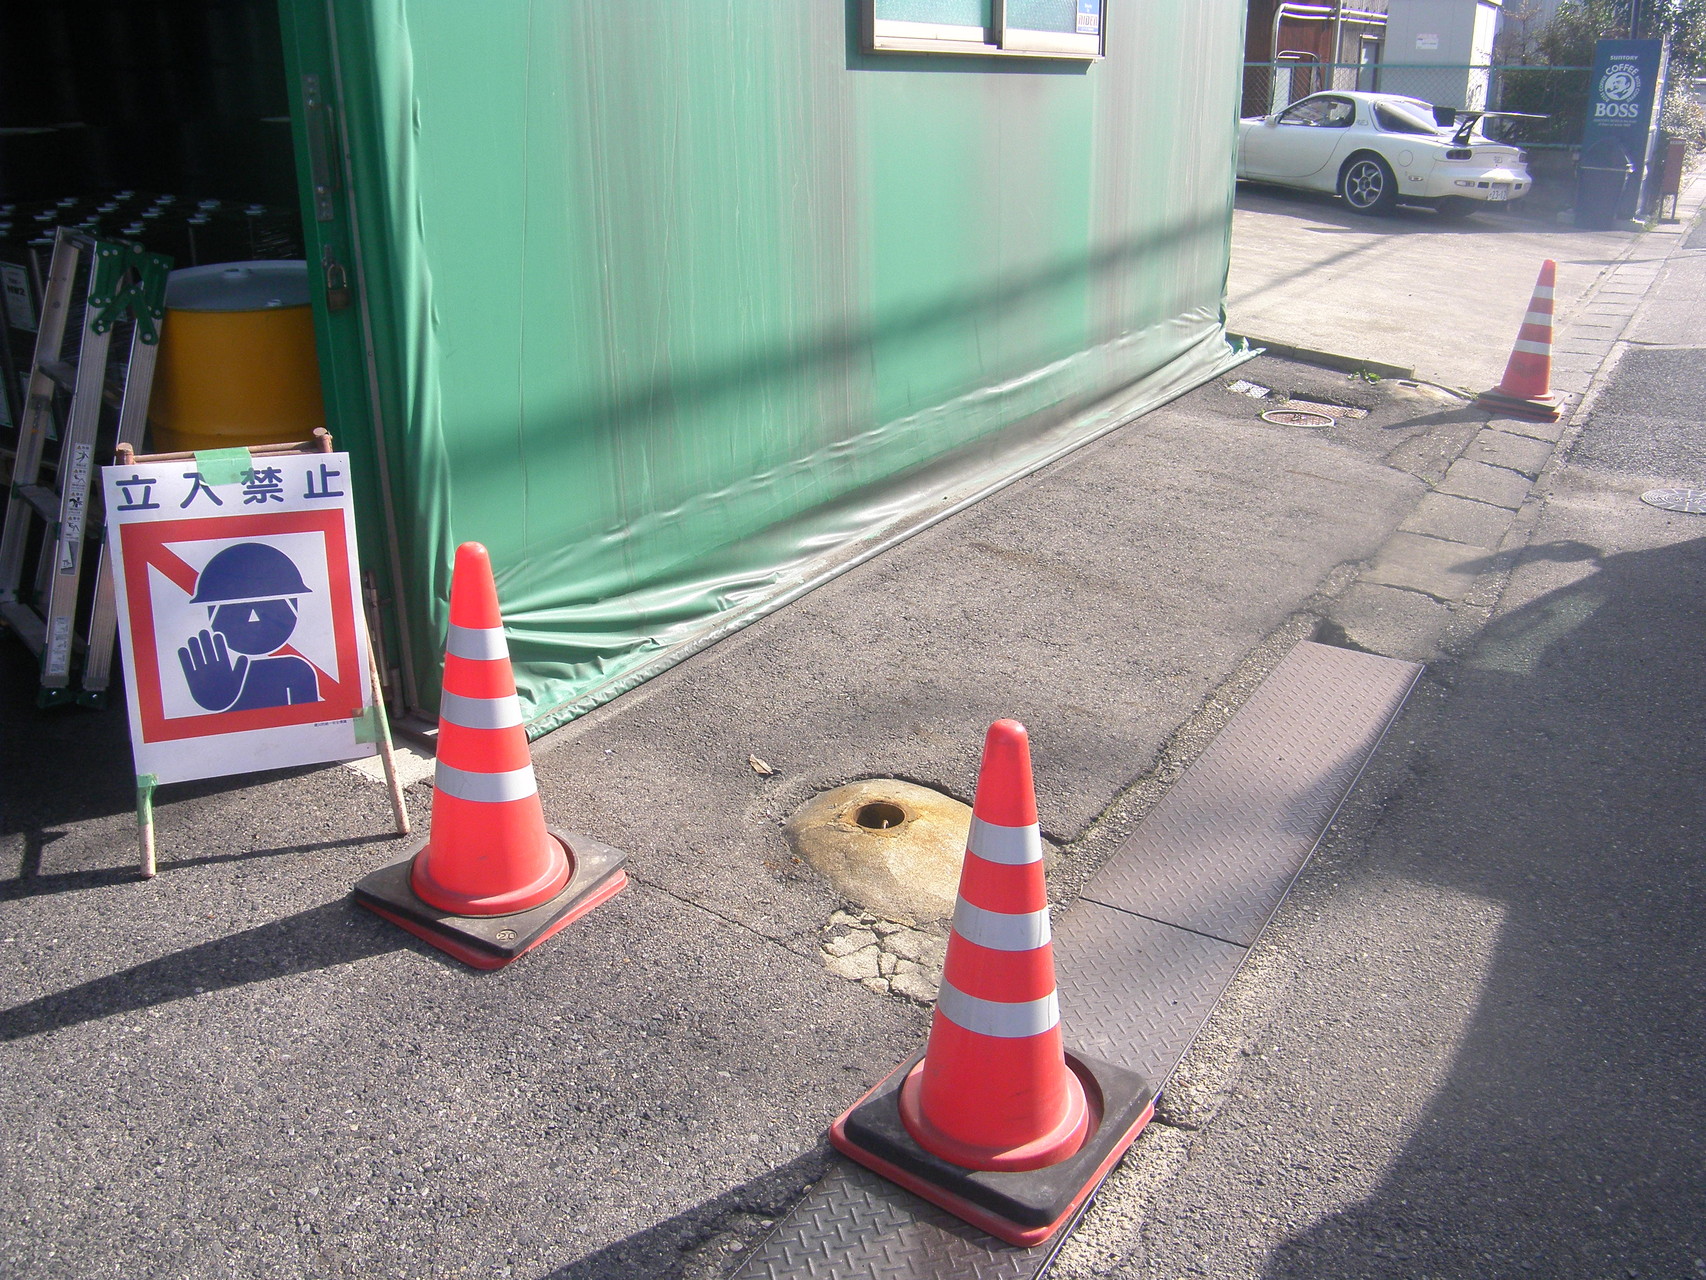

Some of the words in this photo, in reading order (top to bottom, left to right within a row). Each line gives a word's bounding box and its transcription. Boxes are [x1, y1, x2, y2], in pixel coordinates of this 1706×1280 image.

[1605, 63, 1639, 75] COFFEE
[1594, 102, 1639, 117] BOSS
[115, 463, 344, 512] 立入禁止
